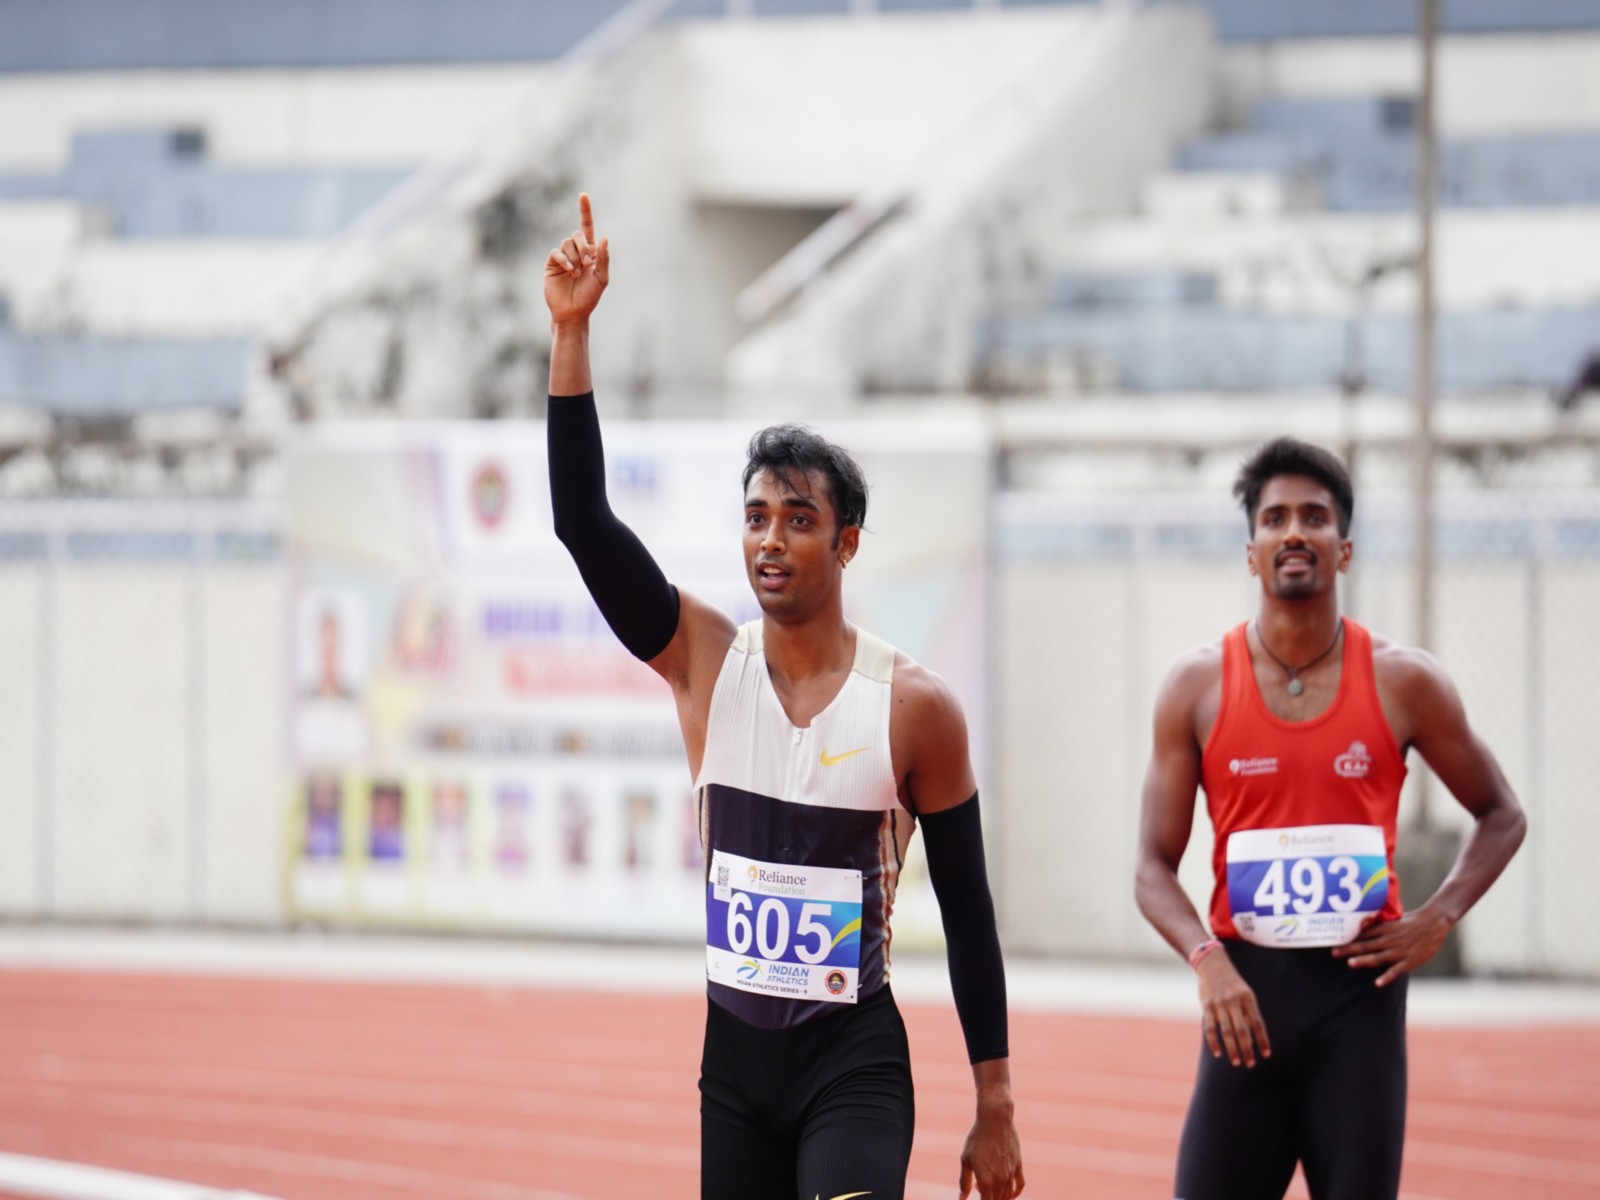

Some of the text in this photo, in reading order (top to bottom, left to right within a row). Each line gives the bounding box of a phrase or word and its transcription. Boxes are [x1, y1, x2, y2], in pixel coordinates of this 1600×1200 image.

[758, 869, 807, 886] Reliance
[758, 883, 806, 896] Foundation
[1253, 857, 1362, 916] 493
[727, 892, 832, 965] 605
[768, 964, 810, 977] INDIAN
[736, 979, 752, 987] INDIAN
[752, 982, 779, 992] ATHLETICS
[780, 986, 799, 994] SERIES
[766, 975, 809, 986] ATHLETICS
